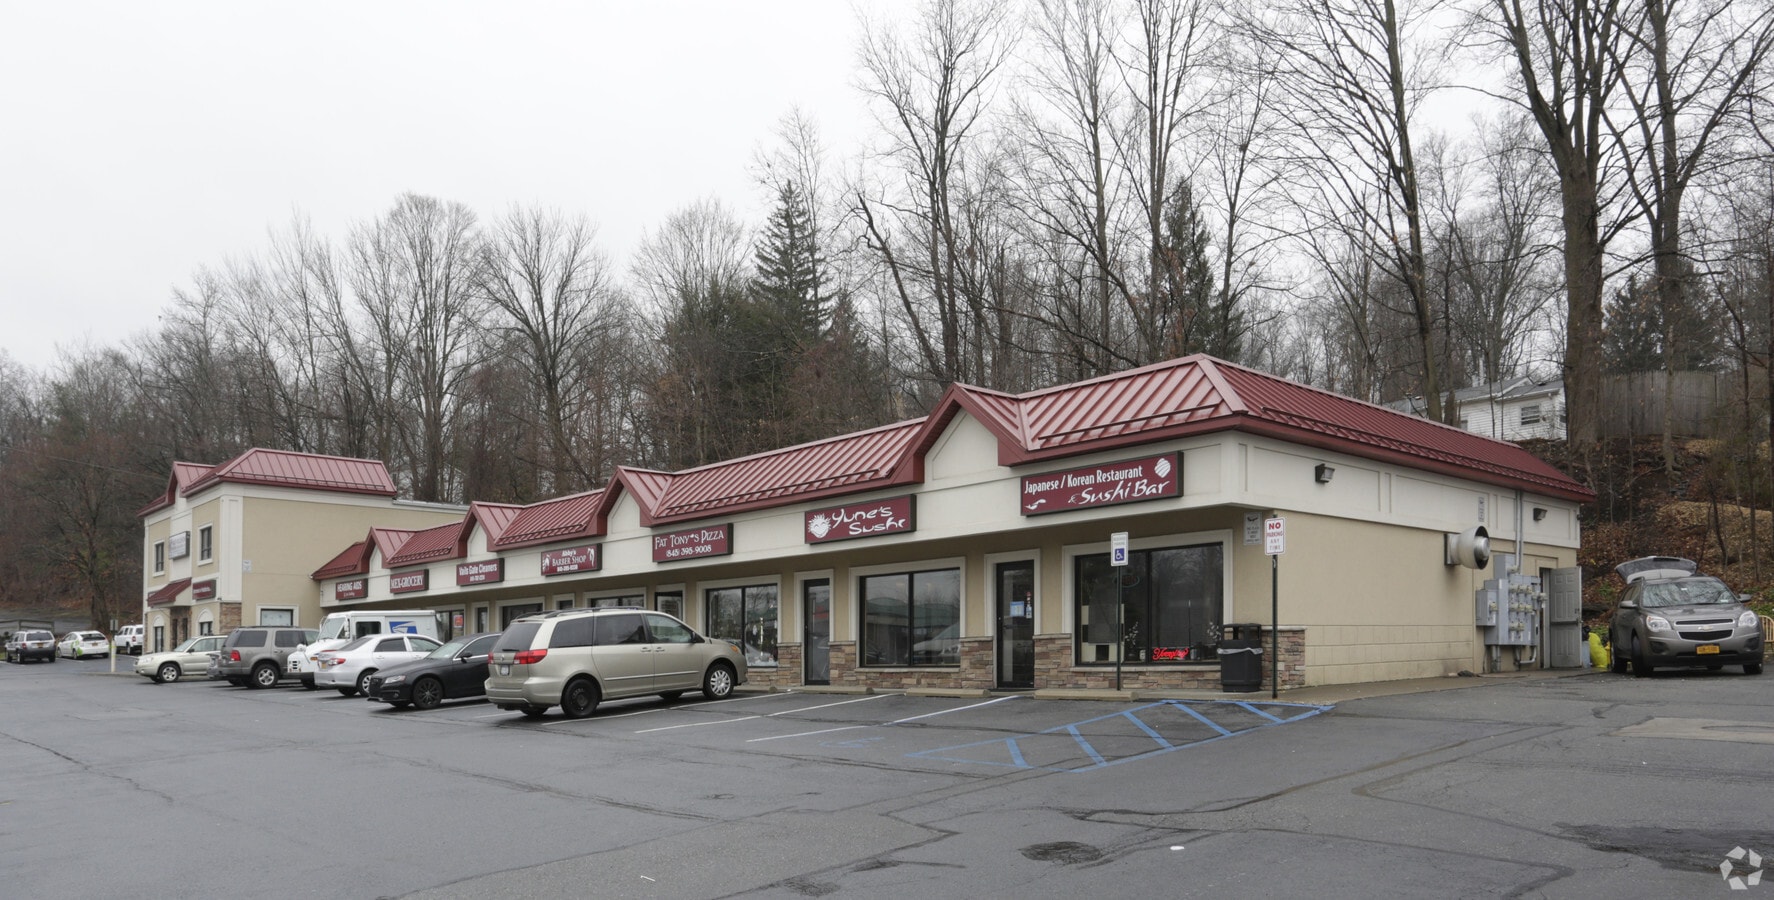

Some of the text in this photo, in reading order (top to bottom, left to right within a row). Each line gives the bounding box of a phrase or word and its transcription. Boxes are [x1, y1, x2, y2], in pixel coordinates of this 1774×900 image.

[1024, 480, 1059, 495] Japanese
[1067, 474, 1095, 488] Korean
[1096, 465, 1143, 483] Restaurant
[1078, 480, 1131, 505] Sushi
[1131, 478, 1171, 497] Bar
[832, 506, 893, 529] Yune's
[849, 517, 906, 535] Sushi
[1268, 522, 1281, 530] NO
[655, 536, 668, 550] FAT
[701, 530, 724, 543] PIZZA
[479, 563, 497, 573] Cleaners
[571, 555, 587, 564] SHOP
